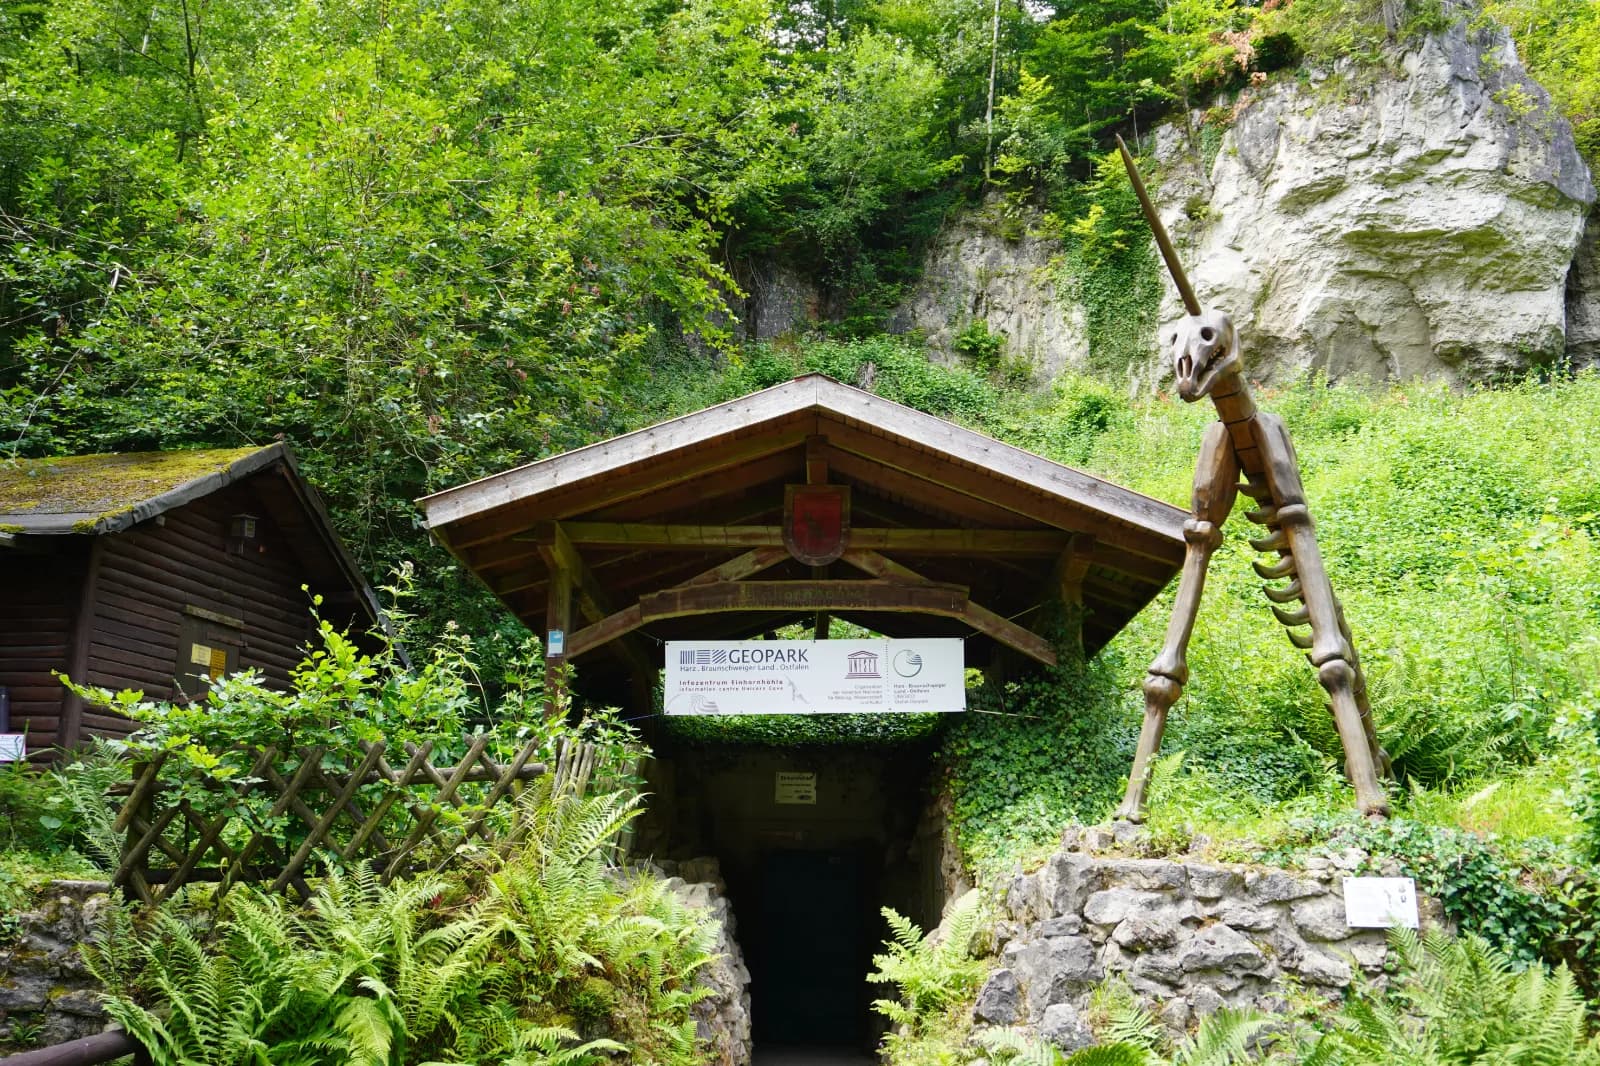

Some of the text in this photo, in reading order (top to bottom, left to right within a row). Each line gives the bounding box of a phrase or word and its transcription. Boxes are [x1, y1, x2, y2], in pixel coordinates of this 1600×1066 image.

[728, 648, 809, 664] GEOPARK
[701, 664, 755, 673] Braunschweiger
[780, 663, 809, 671] Ostfalen
